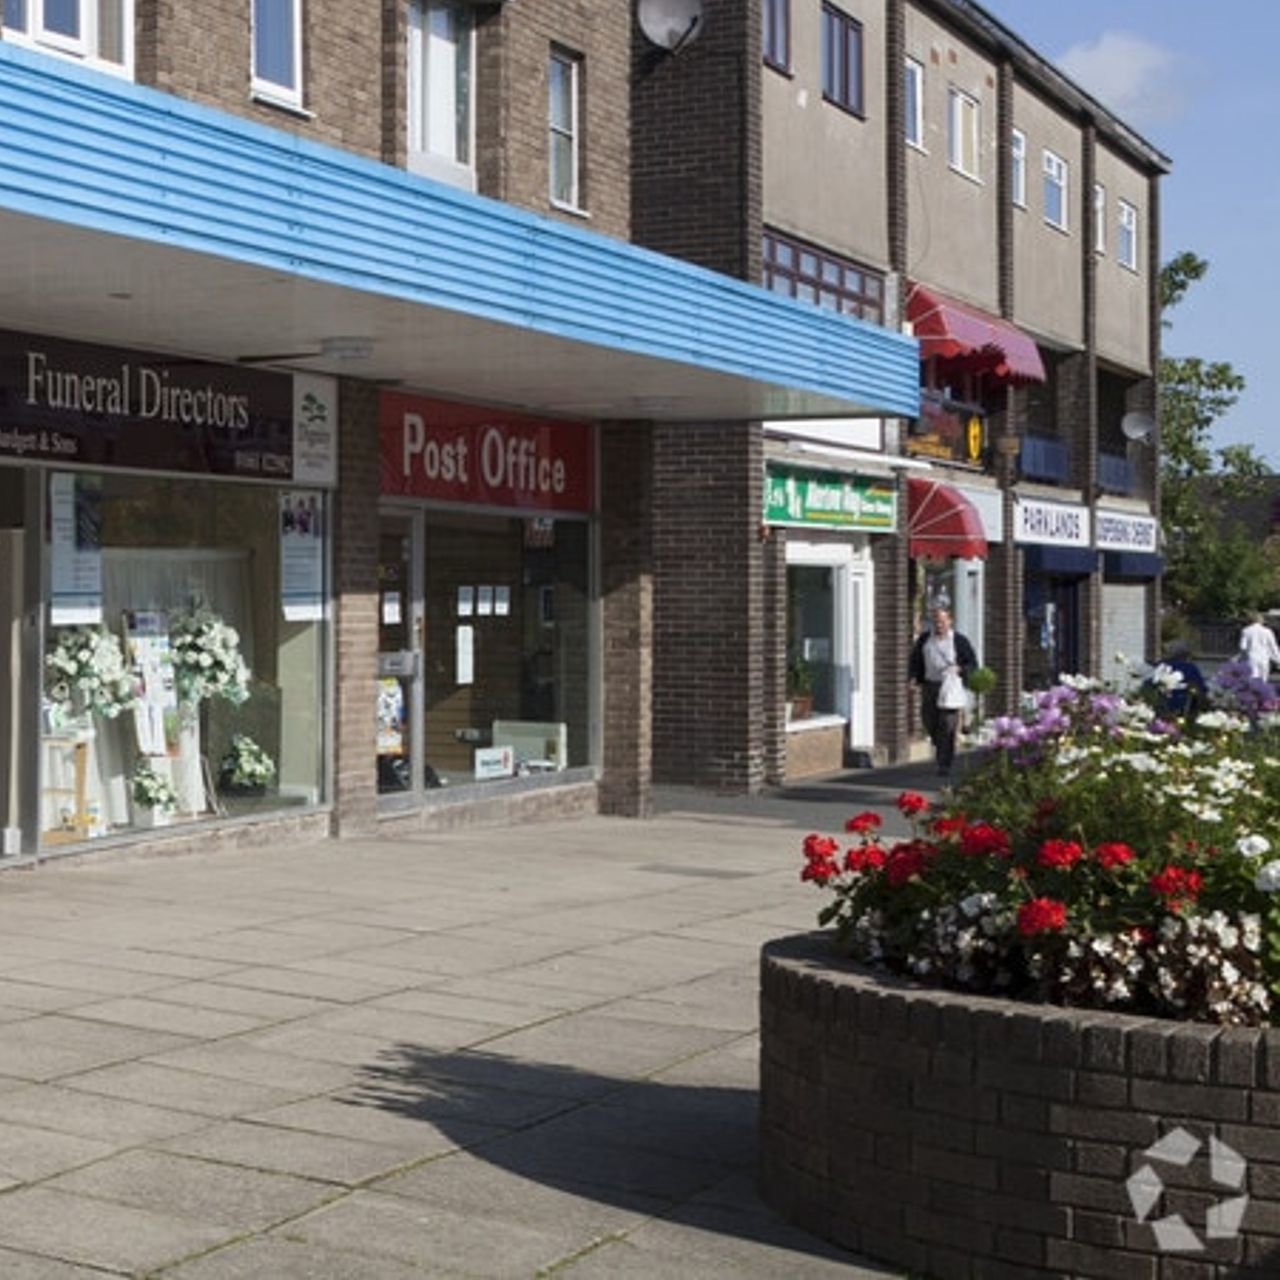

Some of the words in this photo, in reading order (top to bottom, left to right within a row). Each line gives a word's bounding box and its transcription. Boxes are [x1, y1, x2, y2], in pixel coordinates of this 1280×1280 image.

[25, 351, 131, 417] Funeral
[140, 367, 250, 430] Directors
[403, 412, 469, 483] Post
[481, 426, 566, 494] Office
[1023, 505, 1080, 540] PARKLANDS
